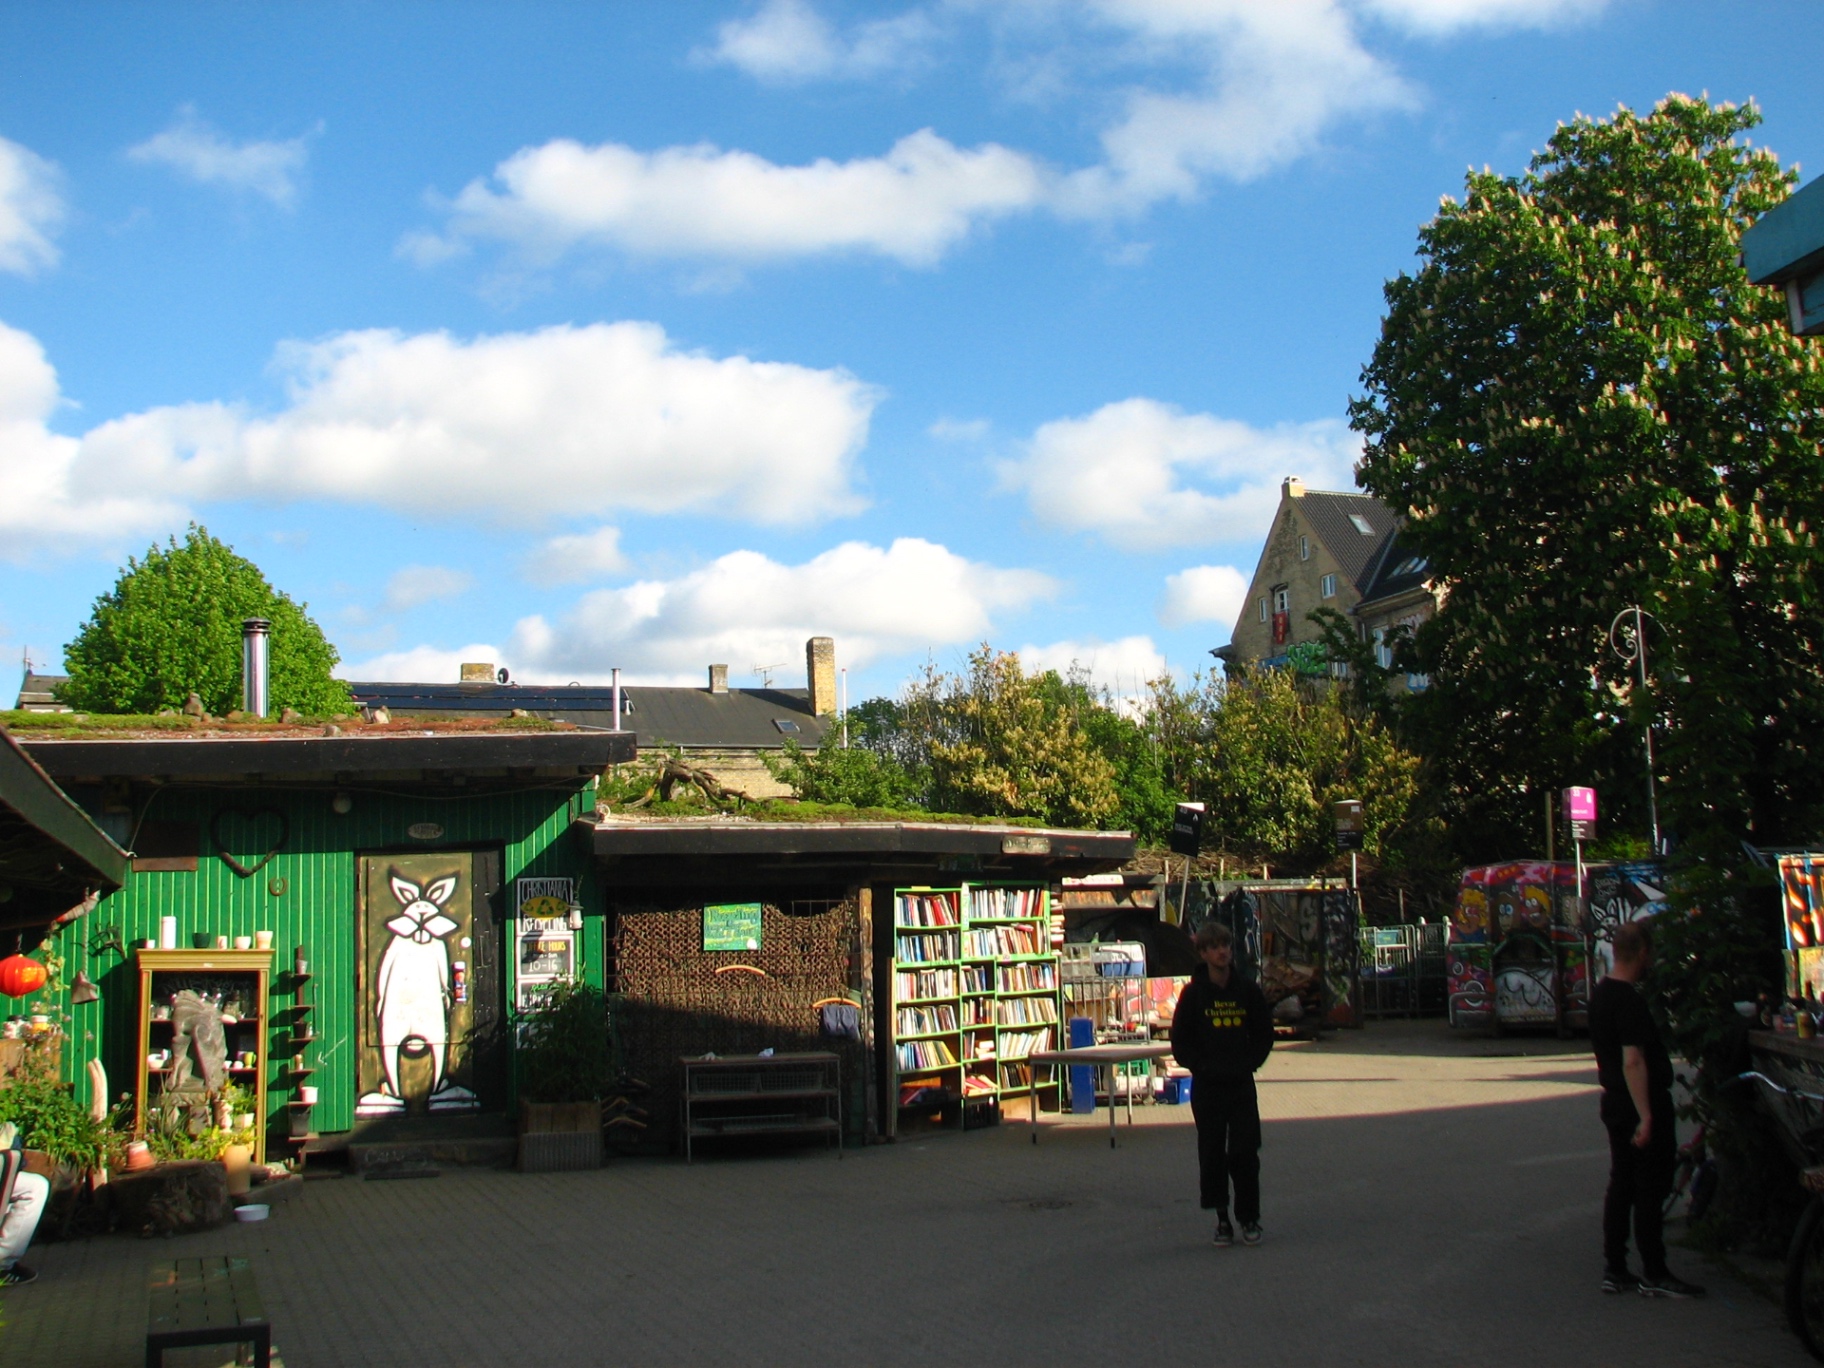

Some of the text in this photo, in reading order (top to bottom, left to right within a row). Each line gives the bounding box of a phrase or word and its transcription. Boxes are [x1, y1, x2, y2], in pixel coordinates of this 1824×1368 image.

[522, 880, 570, 903] CHRISTIANIA
[522, 913, 567, 932] RECYCLING
[548, 940, 567, 952] HOURS
[1213, 1000, 1237, 1009] Bevar
[1204, 1007, 1248, 1017] Christiania
